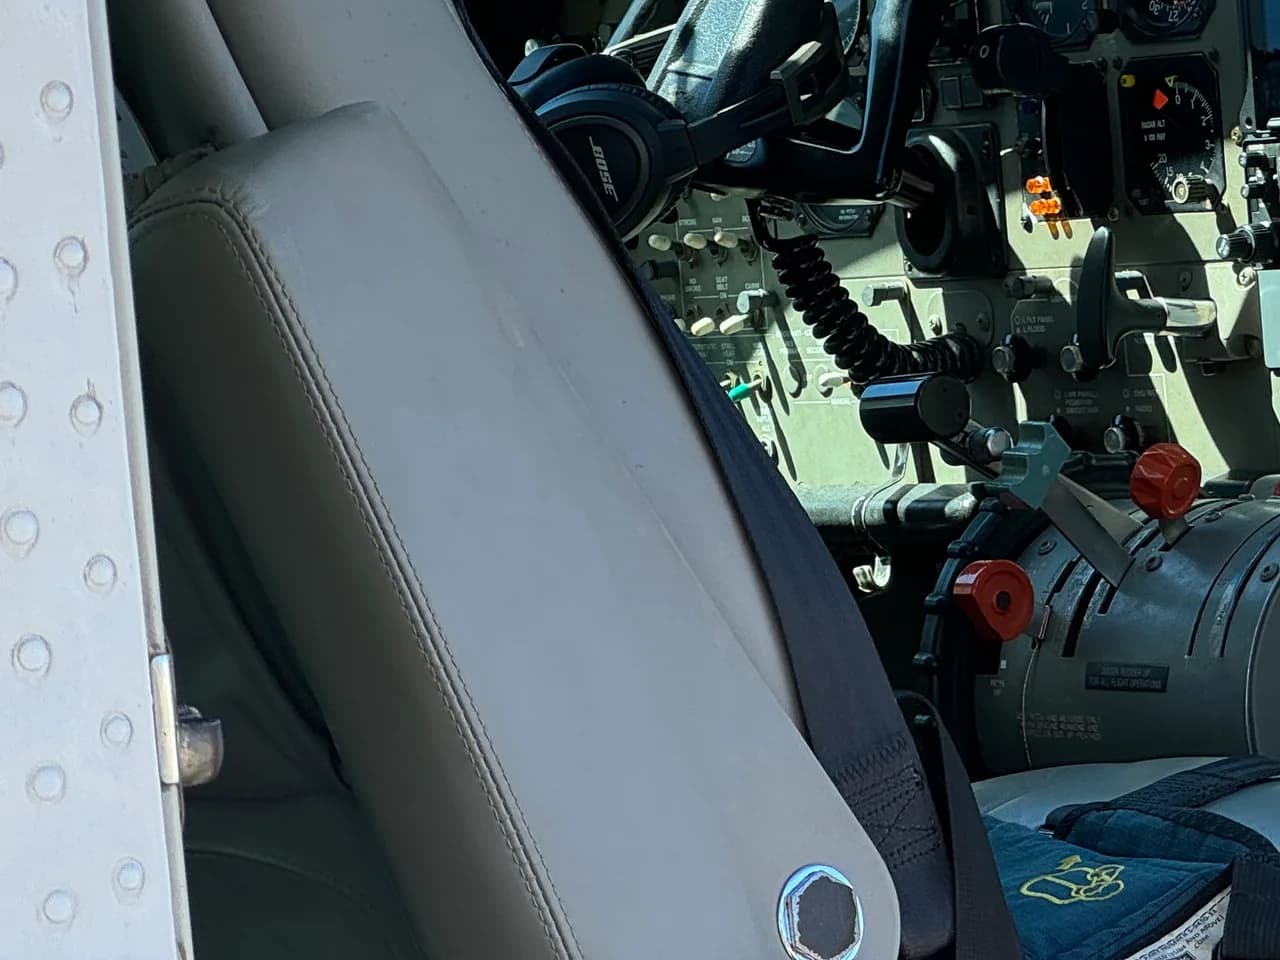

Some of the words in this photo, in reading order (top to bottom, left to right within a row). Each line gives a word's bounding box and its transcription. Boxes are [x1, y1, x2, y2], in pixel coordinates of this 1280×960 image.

[1141, 120, 1156, 128] RADAR
[1156, 120, 1166, 128] ALT
[1157, 154, 1167, 164] 20
[588, 136, 619, 202] BOSE
[1166, 166, 1174, 177] 15
[716, 276, 728, 284] SEAT
